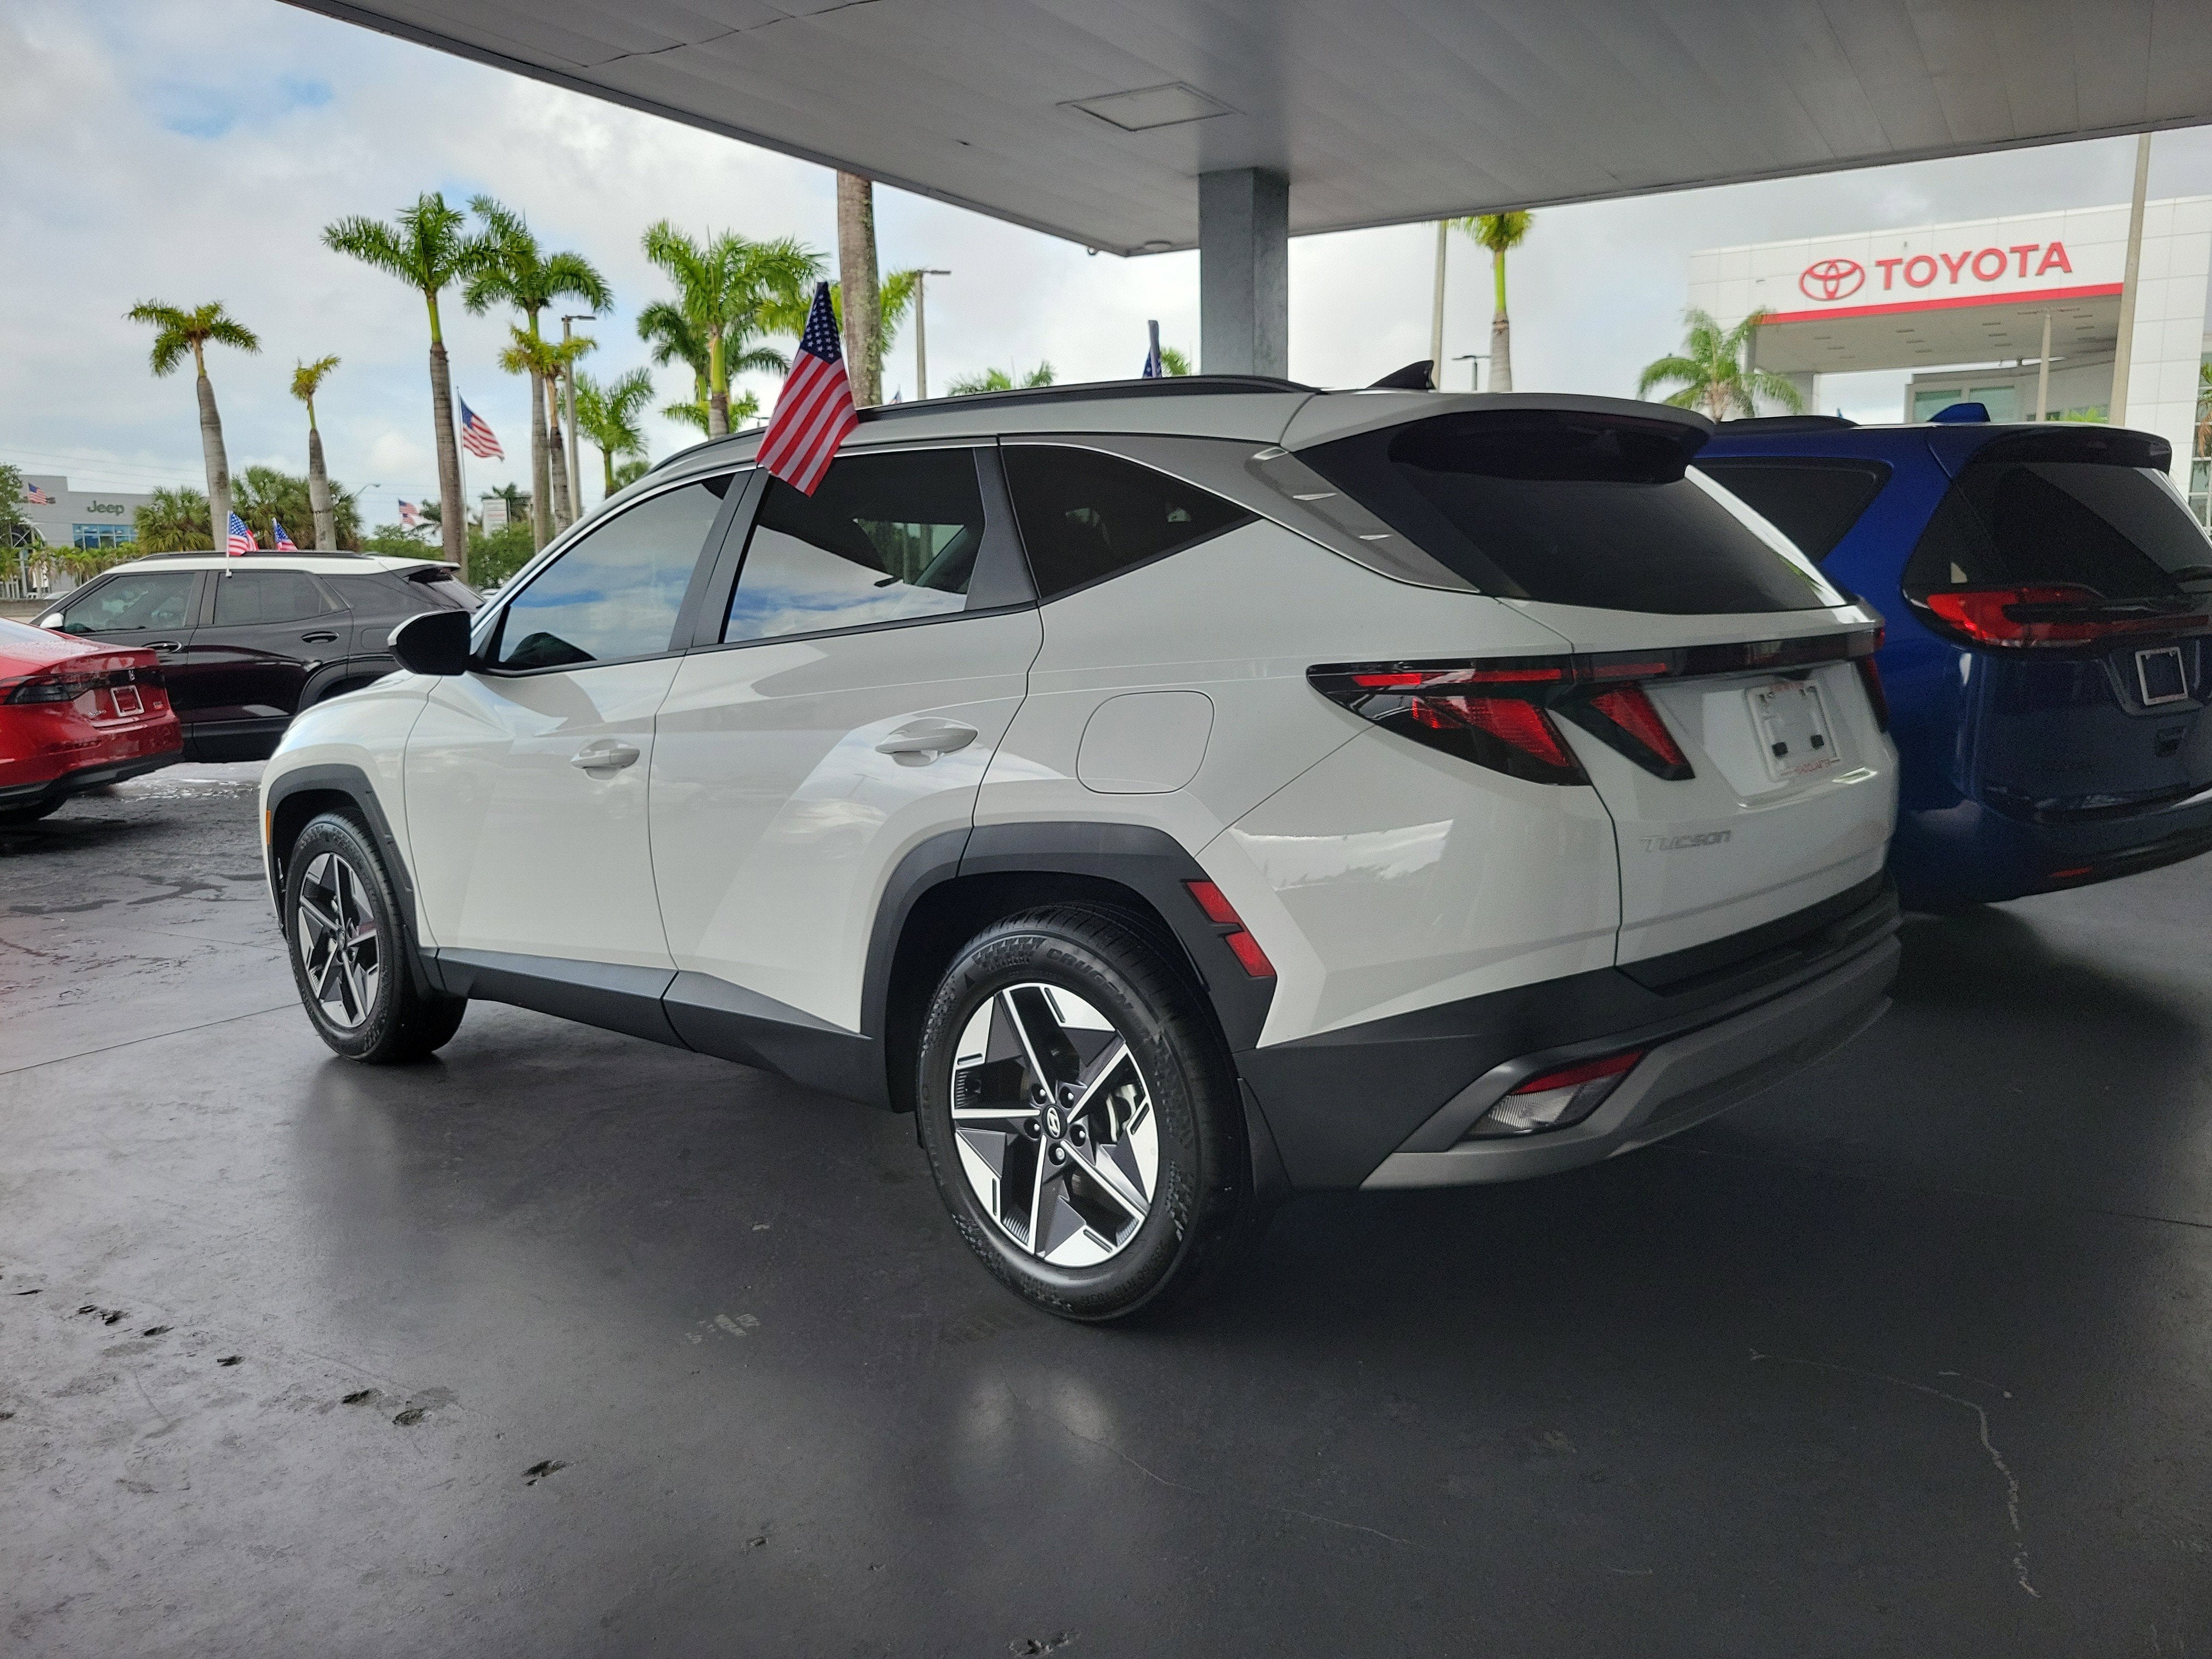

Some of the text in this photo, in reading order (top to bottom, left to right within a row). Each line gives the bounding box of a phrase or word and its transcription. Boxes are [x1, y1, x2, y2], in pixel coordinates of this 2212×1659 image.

[1875, 241, 2073, 291] TOYOTA
[87, 500, 124, 516] Jeep
[1046, 947, 1135, 1010] CRUGEN
